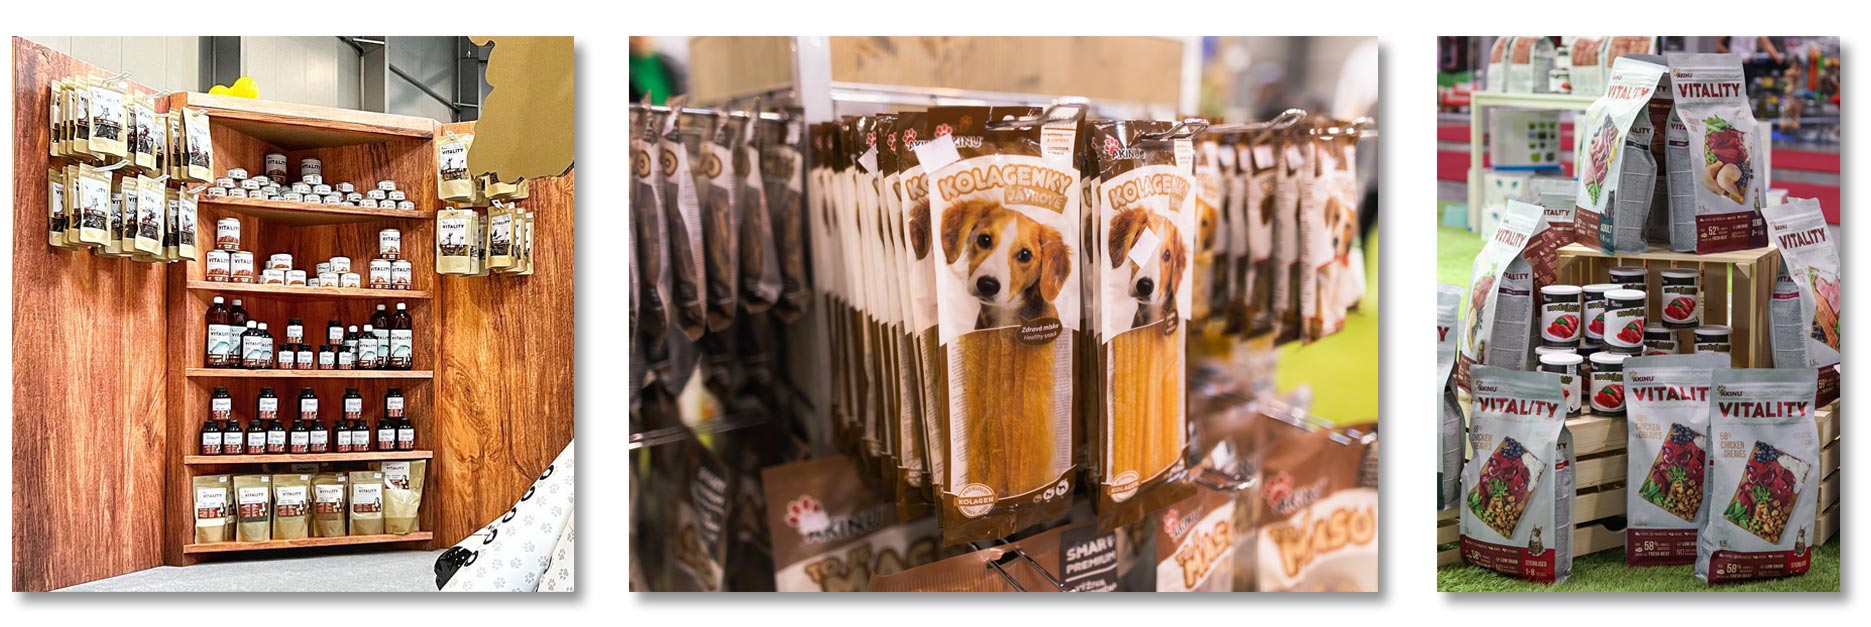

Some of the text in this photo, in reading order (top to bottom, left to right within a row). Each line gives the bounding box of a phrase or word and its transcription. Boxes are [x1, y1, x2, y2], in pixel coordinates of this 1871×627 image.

[1608, 84, 1649, 100] VITALITY
[1678, 82, 1740, 98] VITALITY
[1112, 147, 1141, 160] AKINU
[938, 164, 1073, 200] KOLAGENKY
[1495, 227, 1527, 248] VITALITY
[1778, 227, 1826, 250] VITALITY
[1632, 386, 1711, 402] VITALIT
[1478, 397, 1559, 418] VITALITY
[1718, 401, 1808, 418] VITALITY
[1721, 441, 1745, 449] CHICKEN
[958, 497, 994, 505] KOLAGEN
